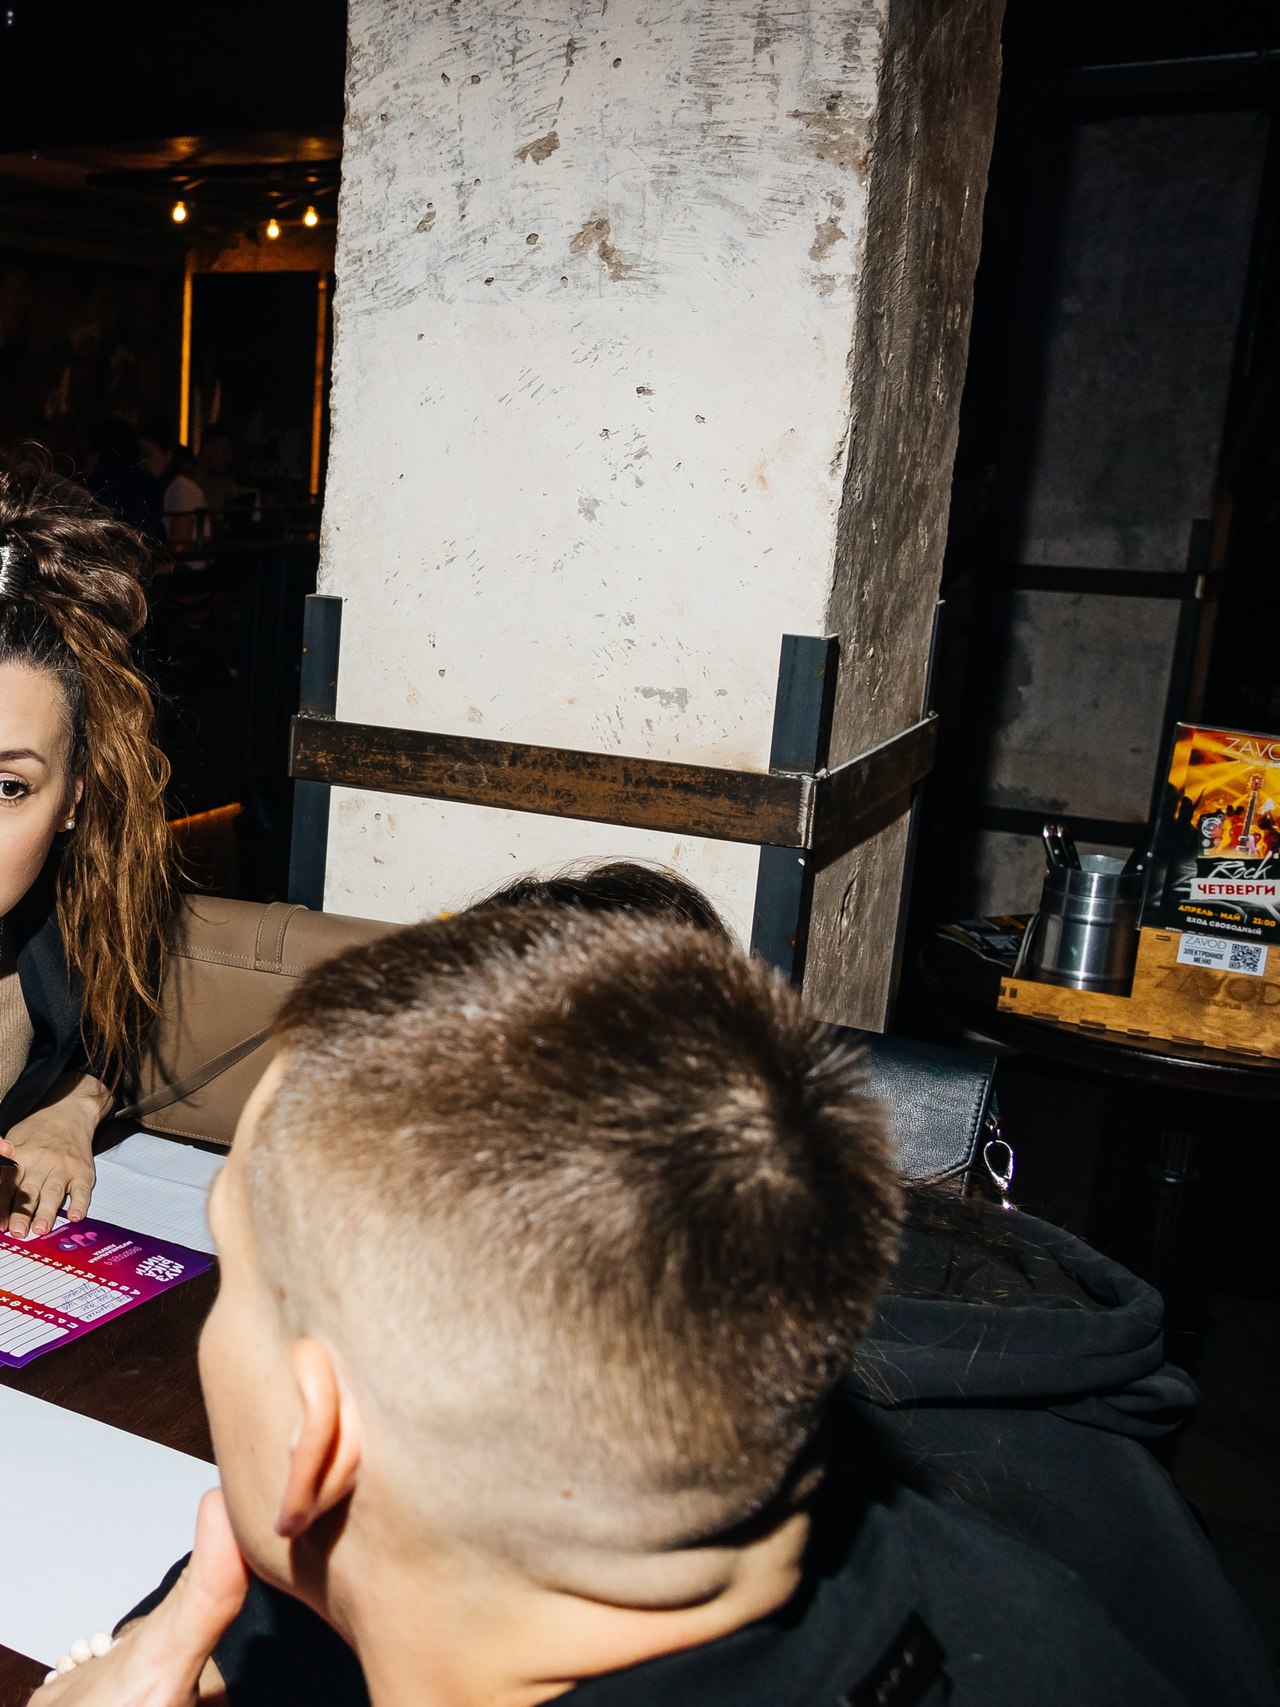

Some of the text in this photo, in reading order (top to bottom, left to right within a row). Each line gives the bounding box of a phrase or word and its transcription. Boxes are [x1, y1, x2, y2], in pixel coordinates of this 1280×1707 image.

[1207, 851, 1273, 880] Rock
[1197, 883, 1276, 896] ЧЕТВЕРГИ
[1178, 904, 1214, 917] АПРЕЛЬ
[1220, 911, 1241, 922] МАЙ
[1252, 916, 1276, 928] 21:00
[1186, 916, 1208, 927] ВХОД
[1209, 920, 1262, 936] СВОБОДНЫЙ
[1184, 935, 1228, 950] ZAVOD
[1183, 947, 1224, 961] ЭЛЕКТРОННОЕ
[1193, 956, 1212, 966] МЕНЮ
[61, 1264, 76, 1272] Ж
[155, 1262, 185, 1282] МУЗ
